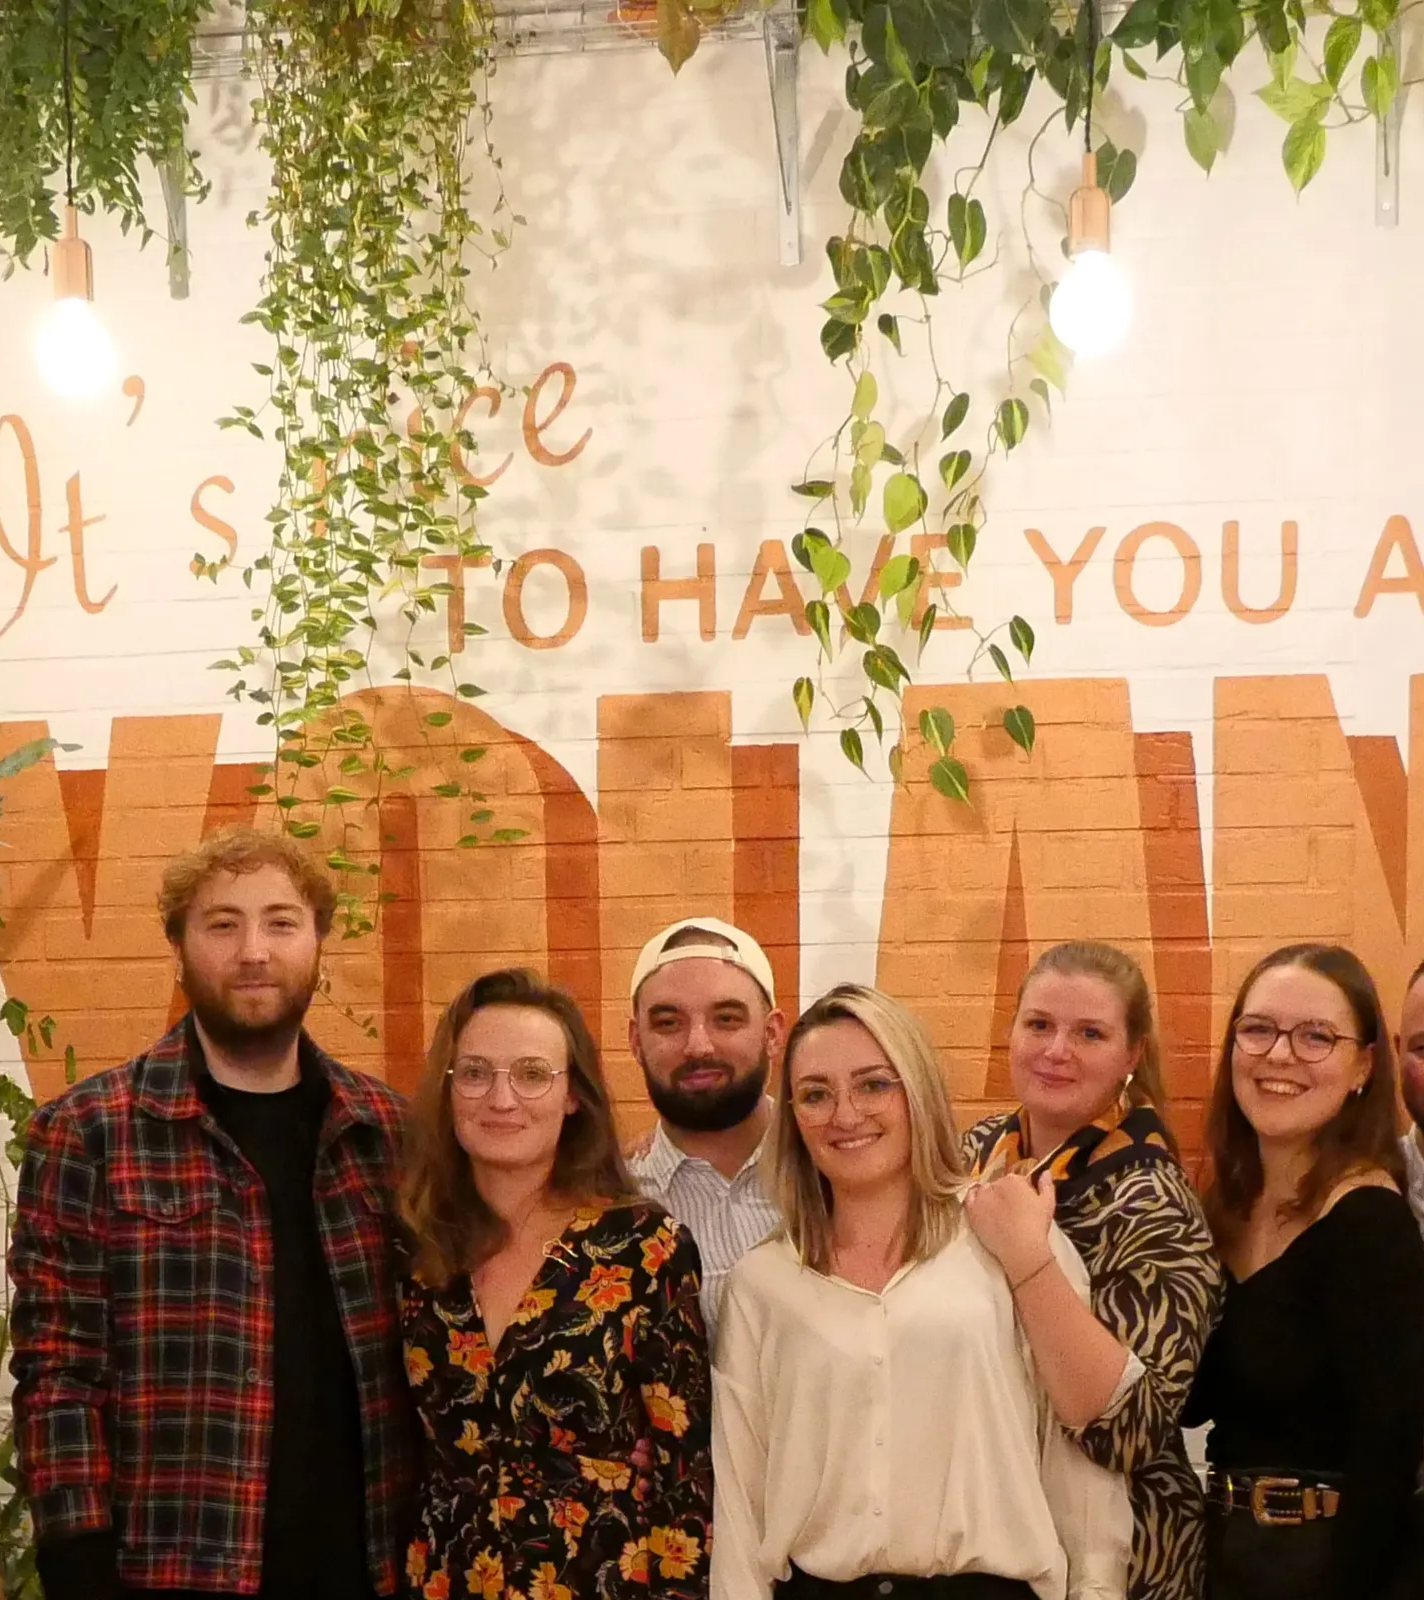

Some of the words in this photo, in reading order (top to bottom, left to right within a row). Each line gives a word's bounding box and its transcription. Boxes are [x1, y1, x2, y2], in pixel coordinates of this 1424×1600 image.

[420, 547, 590, 655] TO
[639, 532, 975, 645] HAVE
[1023, 520, 1300, 627] YOU
